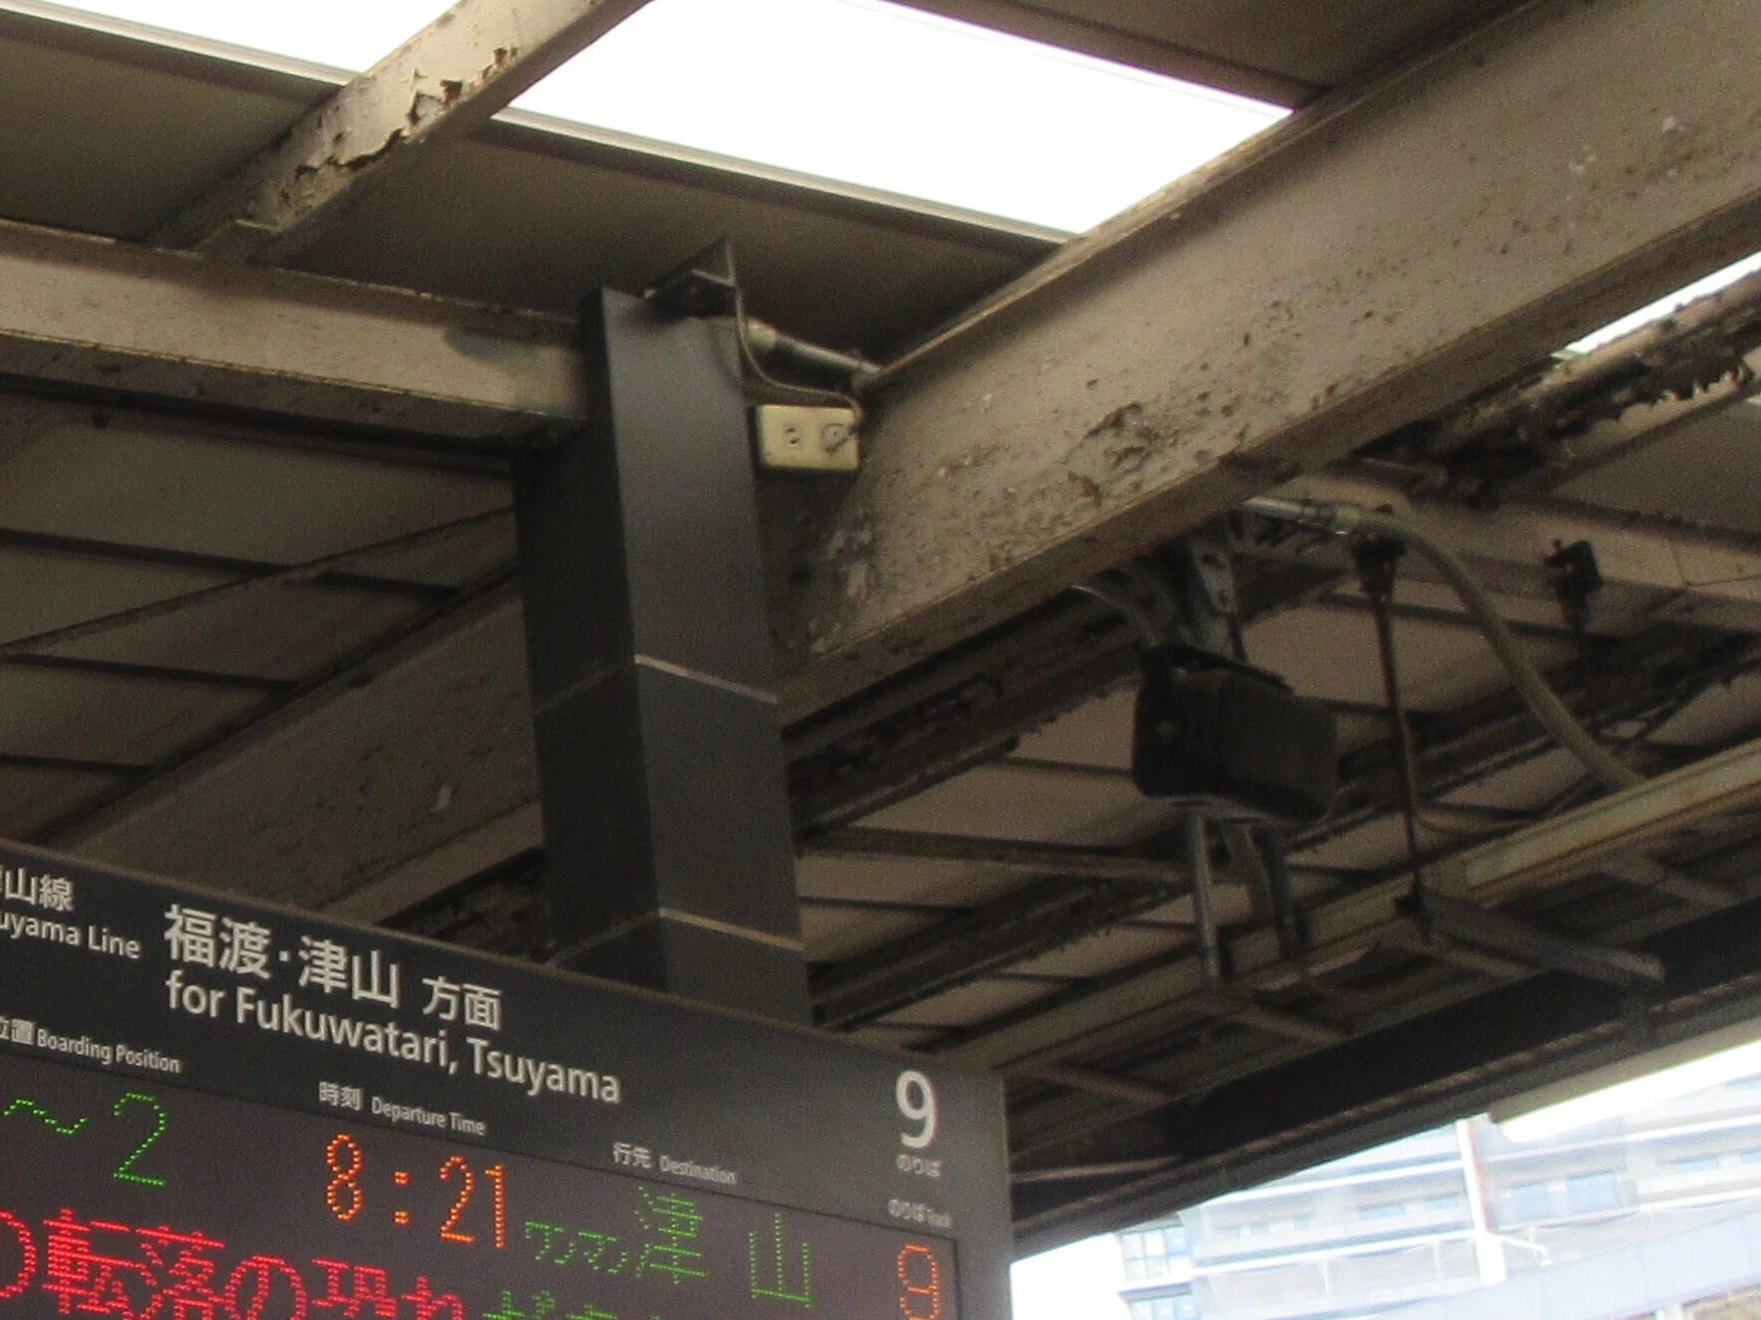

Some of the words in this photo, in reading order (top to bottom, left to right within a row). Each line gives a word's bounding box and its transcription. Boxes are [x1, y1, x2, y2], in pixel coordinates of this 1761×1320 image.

[88, 924, 141, 960] Line
[421, 975, 504, 1032] 方面
[36, 1028, 114, 1066] Boarding
[115, 1044, 182, 1075] Position
[166, 969, 225, 1018] for
[236, 985, 458, 1076] Fukuwatari,
[466, 1036, 624, 1104] Tsuyama
[318, 1080, 361, 1112] 時刻
[371, 1094, 447, 1128] Departure
[448, 1110, 486, 1137] Time
[894, 1068, 936, 1149] 9
[612, 1141, 652, 1169] 行先
[659, 1154, 737, 1184] Destination
